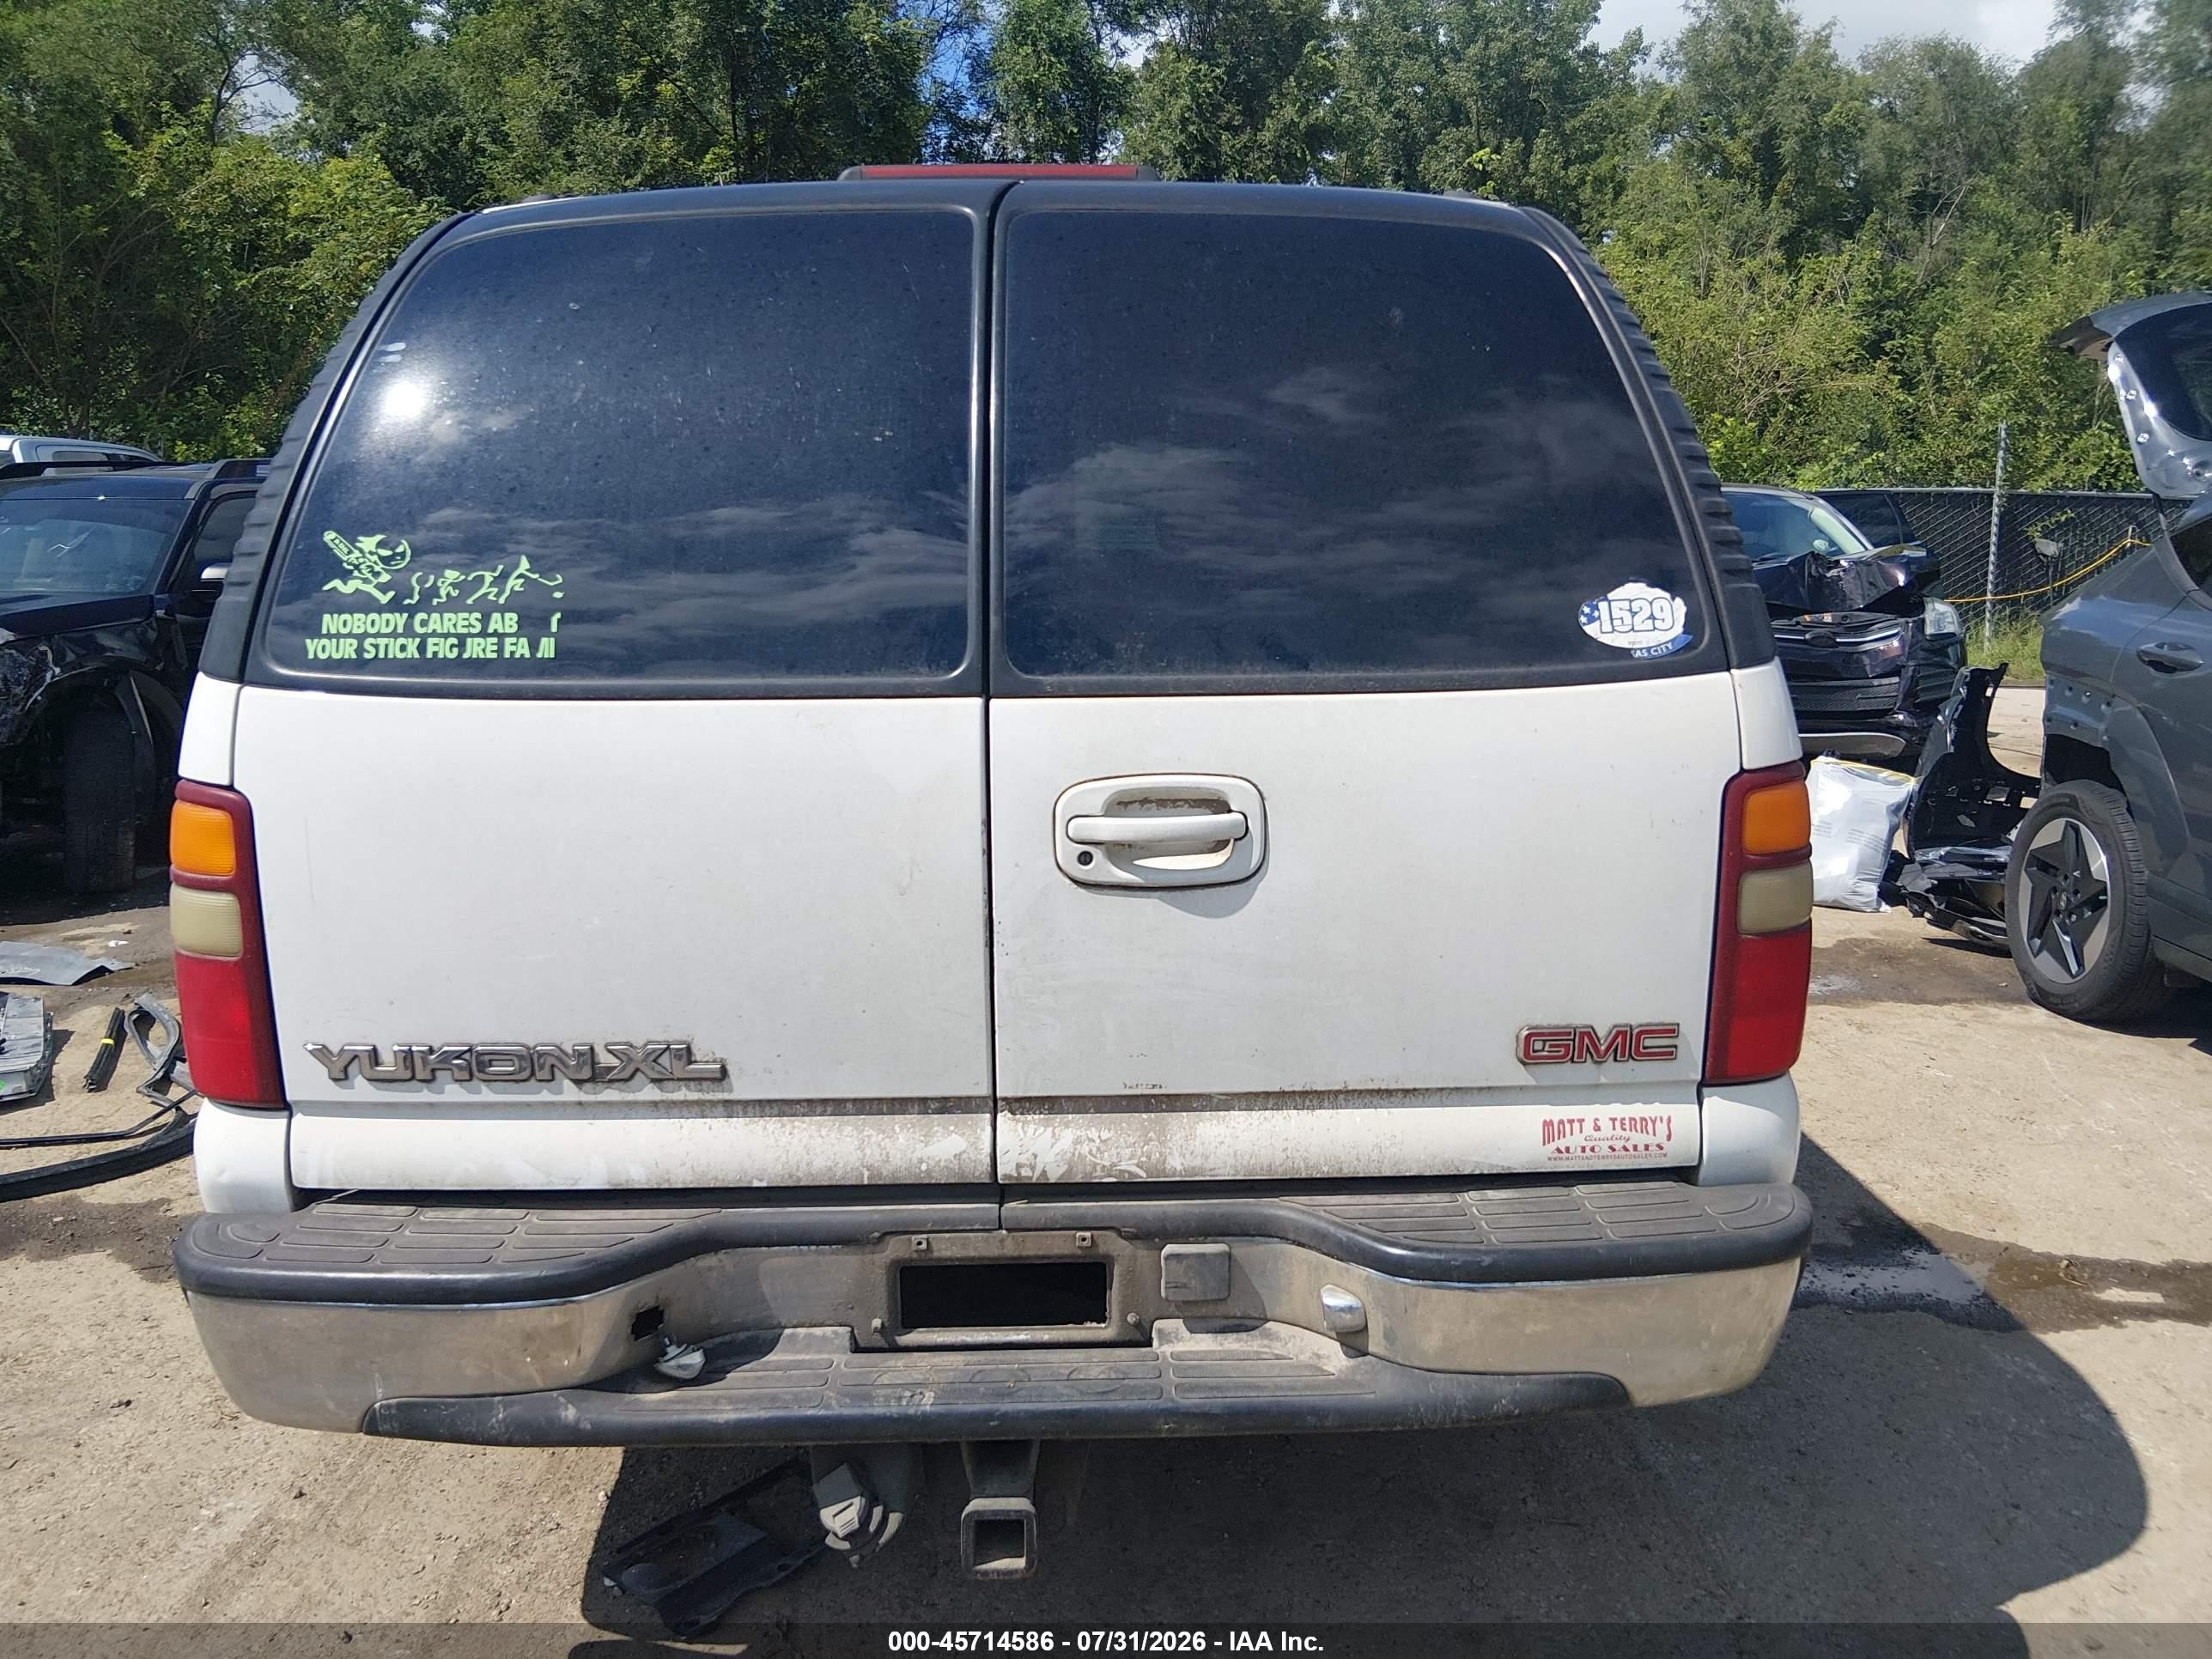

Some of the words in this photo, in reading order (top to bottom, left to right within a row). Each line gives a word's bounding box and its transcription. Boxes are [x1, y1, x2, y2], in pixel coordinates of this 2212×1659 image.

[321, 612, 409, 635] NOBODY
[413, 612, 482, 634] CARES
[1598, 597, 1674, 634] 1529
[305, 638, 359, 659] YOUR
[362, 638, 421, 659] STICK
[1650, 641, 1674, 656] CITY
[1516, 1023, 1679, 1065] GMC
[303, 1042, 594, 1082] YUKON
[603, 1042, 728, 1082] XL
[1542, 1117, 1585, 1146] MATT
[1593, 1117, 1601, 1132] &
[1608, 1115, 1673, 1142] TERRY'S
[1584, 1134, 1632, 1143] Quality
[1552, 1144, 1601, 1154] AUTO
[1607, 1142, 1664, 1153] SALES
